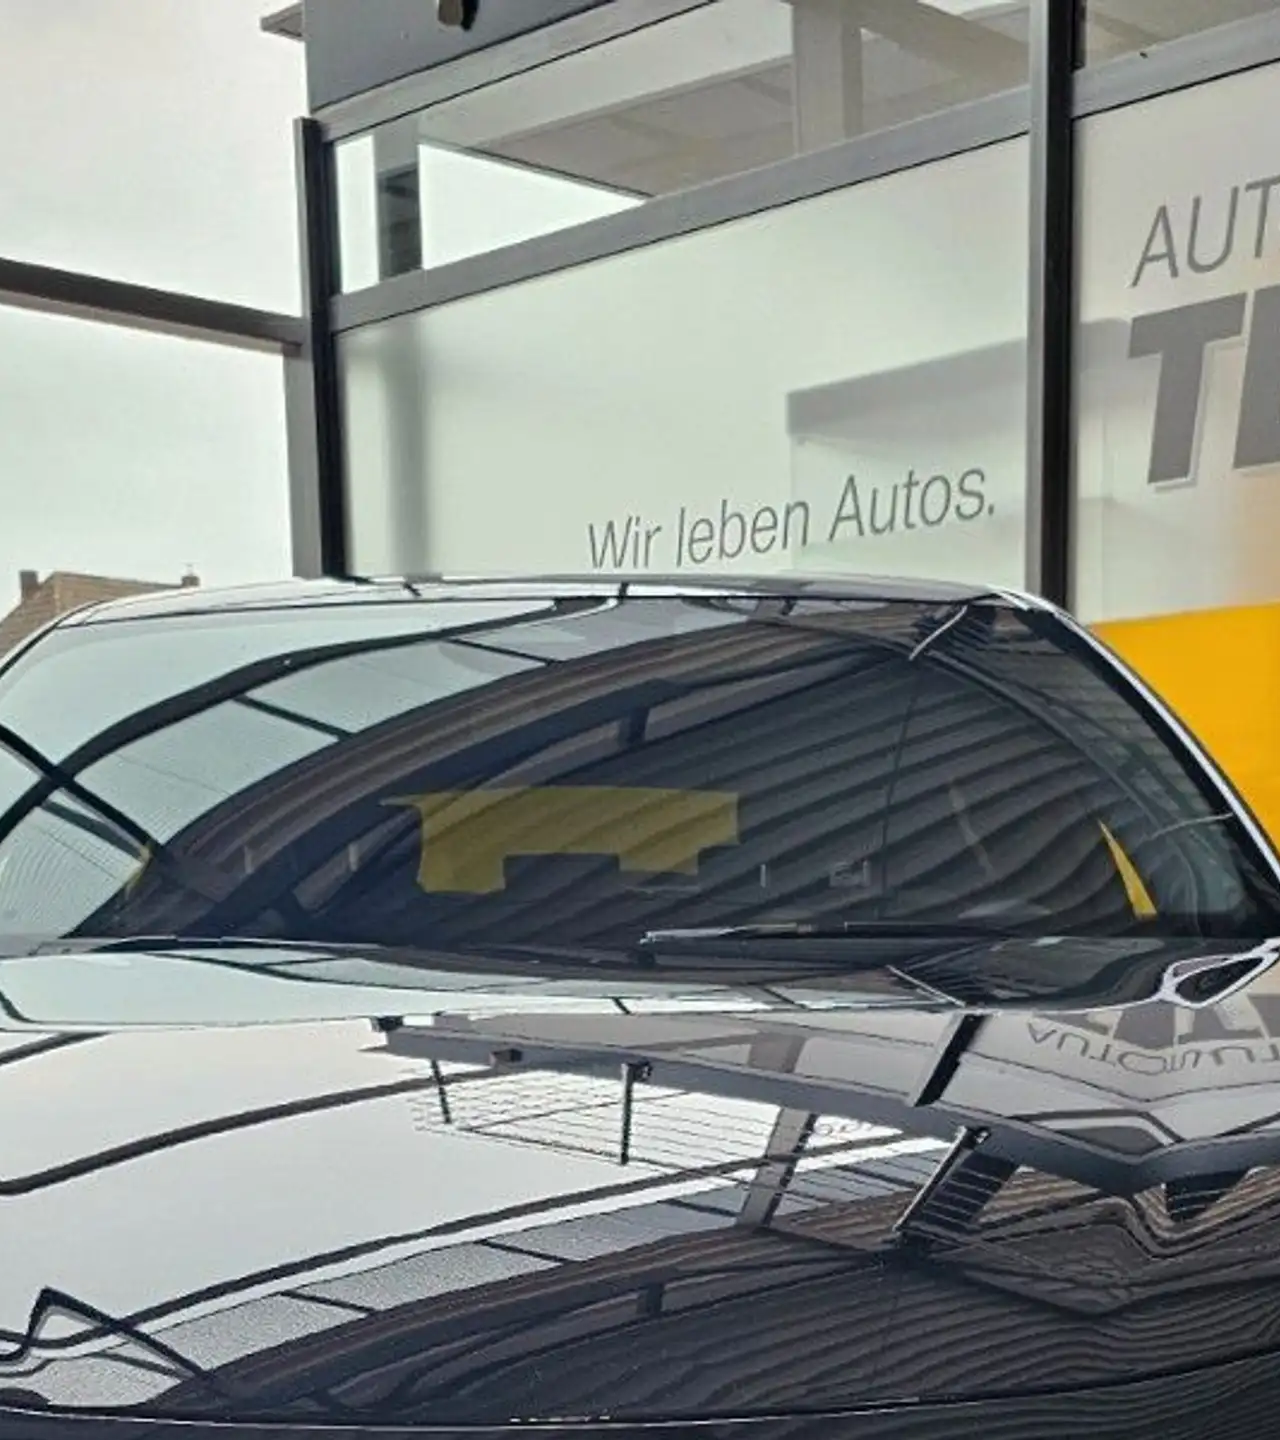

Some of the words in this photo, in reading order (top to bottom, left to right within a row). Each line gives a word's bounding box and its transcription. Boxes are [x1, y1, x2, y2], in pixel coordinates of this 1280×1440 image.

[587, 515, 663, 569] Wir
[676, 499, 810, 568] leben
[827, 468, 996, 542] Autos.
